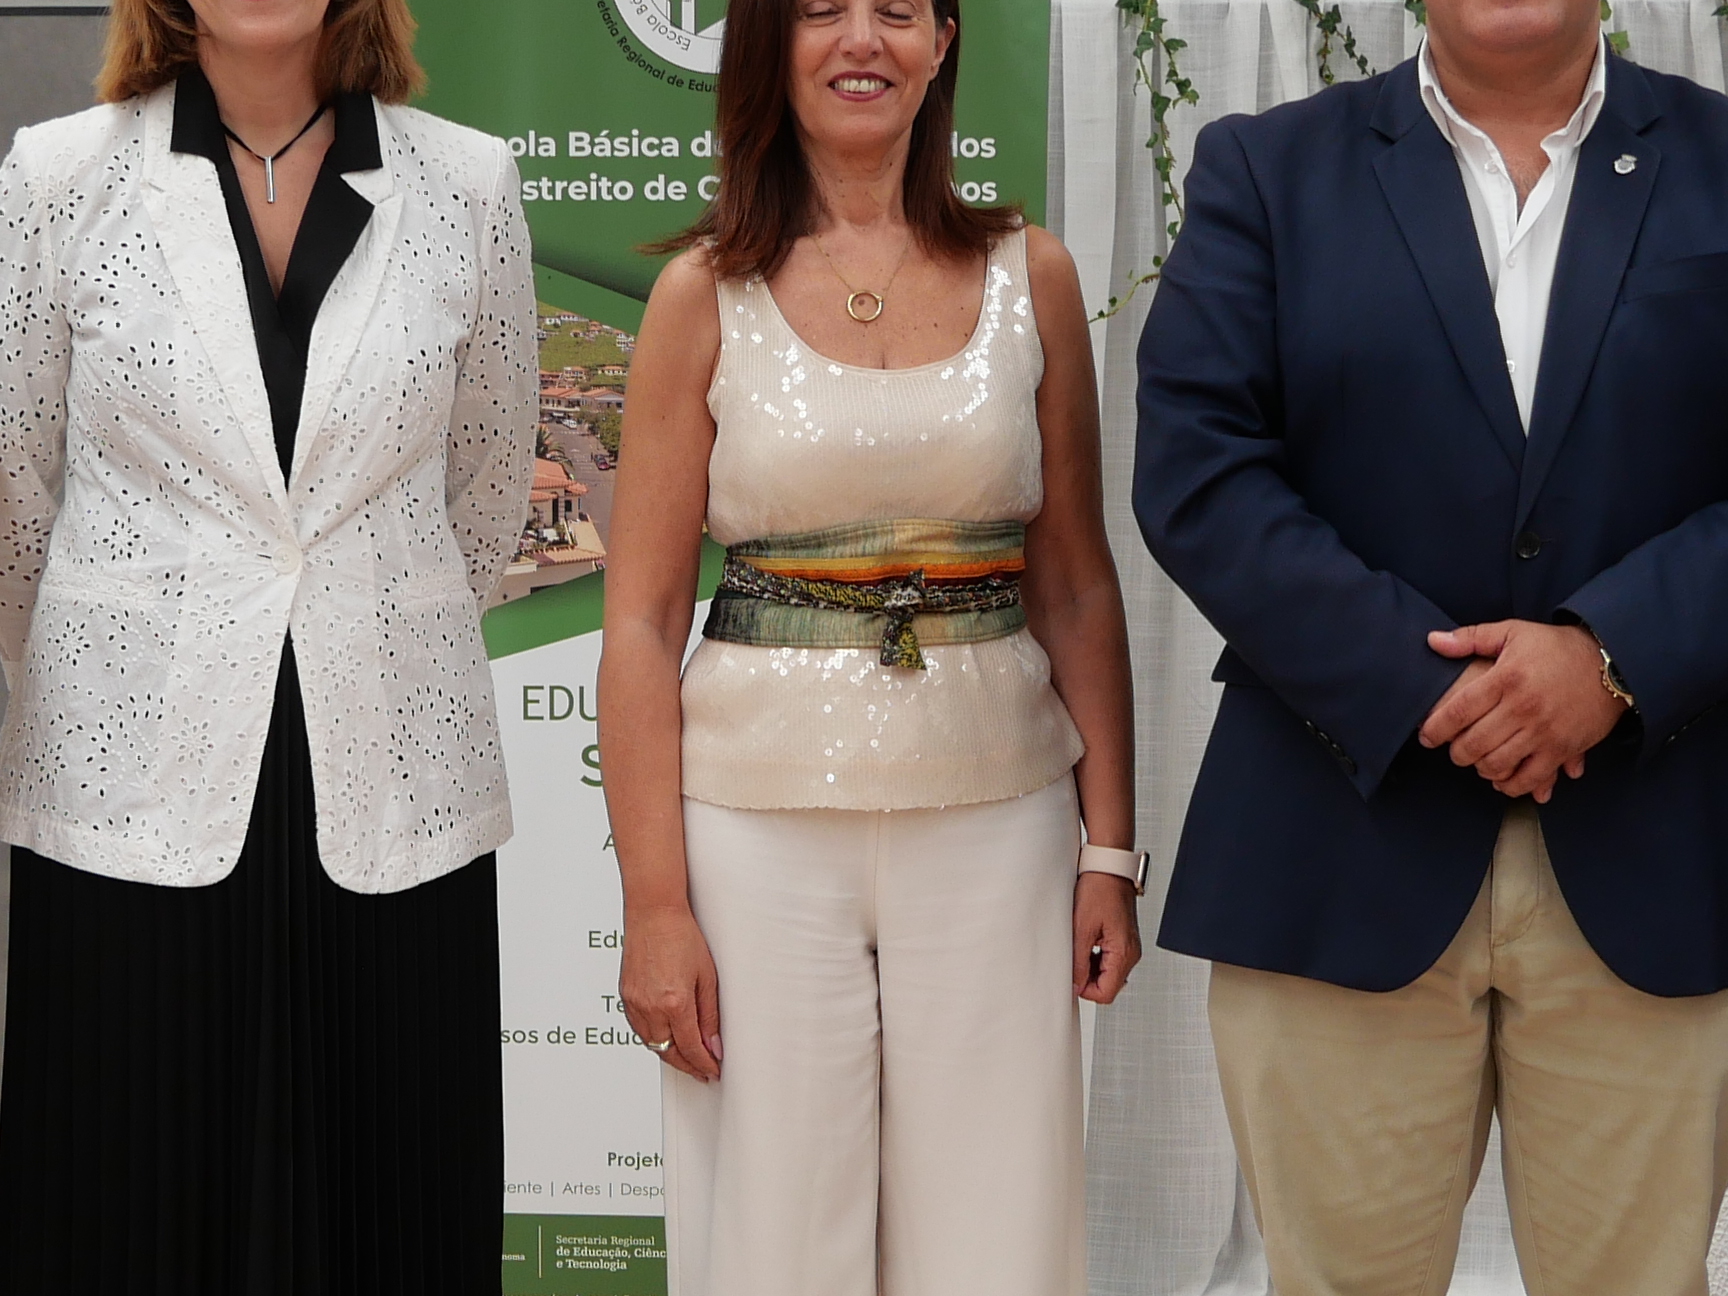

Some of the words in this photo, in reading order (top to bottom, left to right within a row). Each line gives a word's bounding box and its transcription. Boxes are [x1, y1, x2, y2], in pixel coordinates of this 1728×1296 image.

[647, 15, 691, 51] Escola
[617, 35, 666, 80] Regional
[667, 75, 684, 88] de
[568, 129, 679, 157] Básica
[522, 173, 634, 201] streito
[644, 174, 687, 201] de
[951, 181, 997, 202] os
[547, 1026, 576, 1044] de
[607, 1151, 664, 1170] Projet
[562, 1182, 601, 1196] Artes
[556, 1235, 607, 1245] Secretaria
[611, 1236, 655, 1247] Regional
[556, 1246, 570, 1257] de
[573, 1247, 631, 1259] Educação,
[556, 1260, 563, 1269] e
[566, 1259, 627, 1271] Tecnologia
